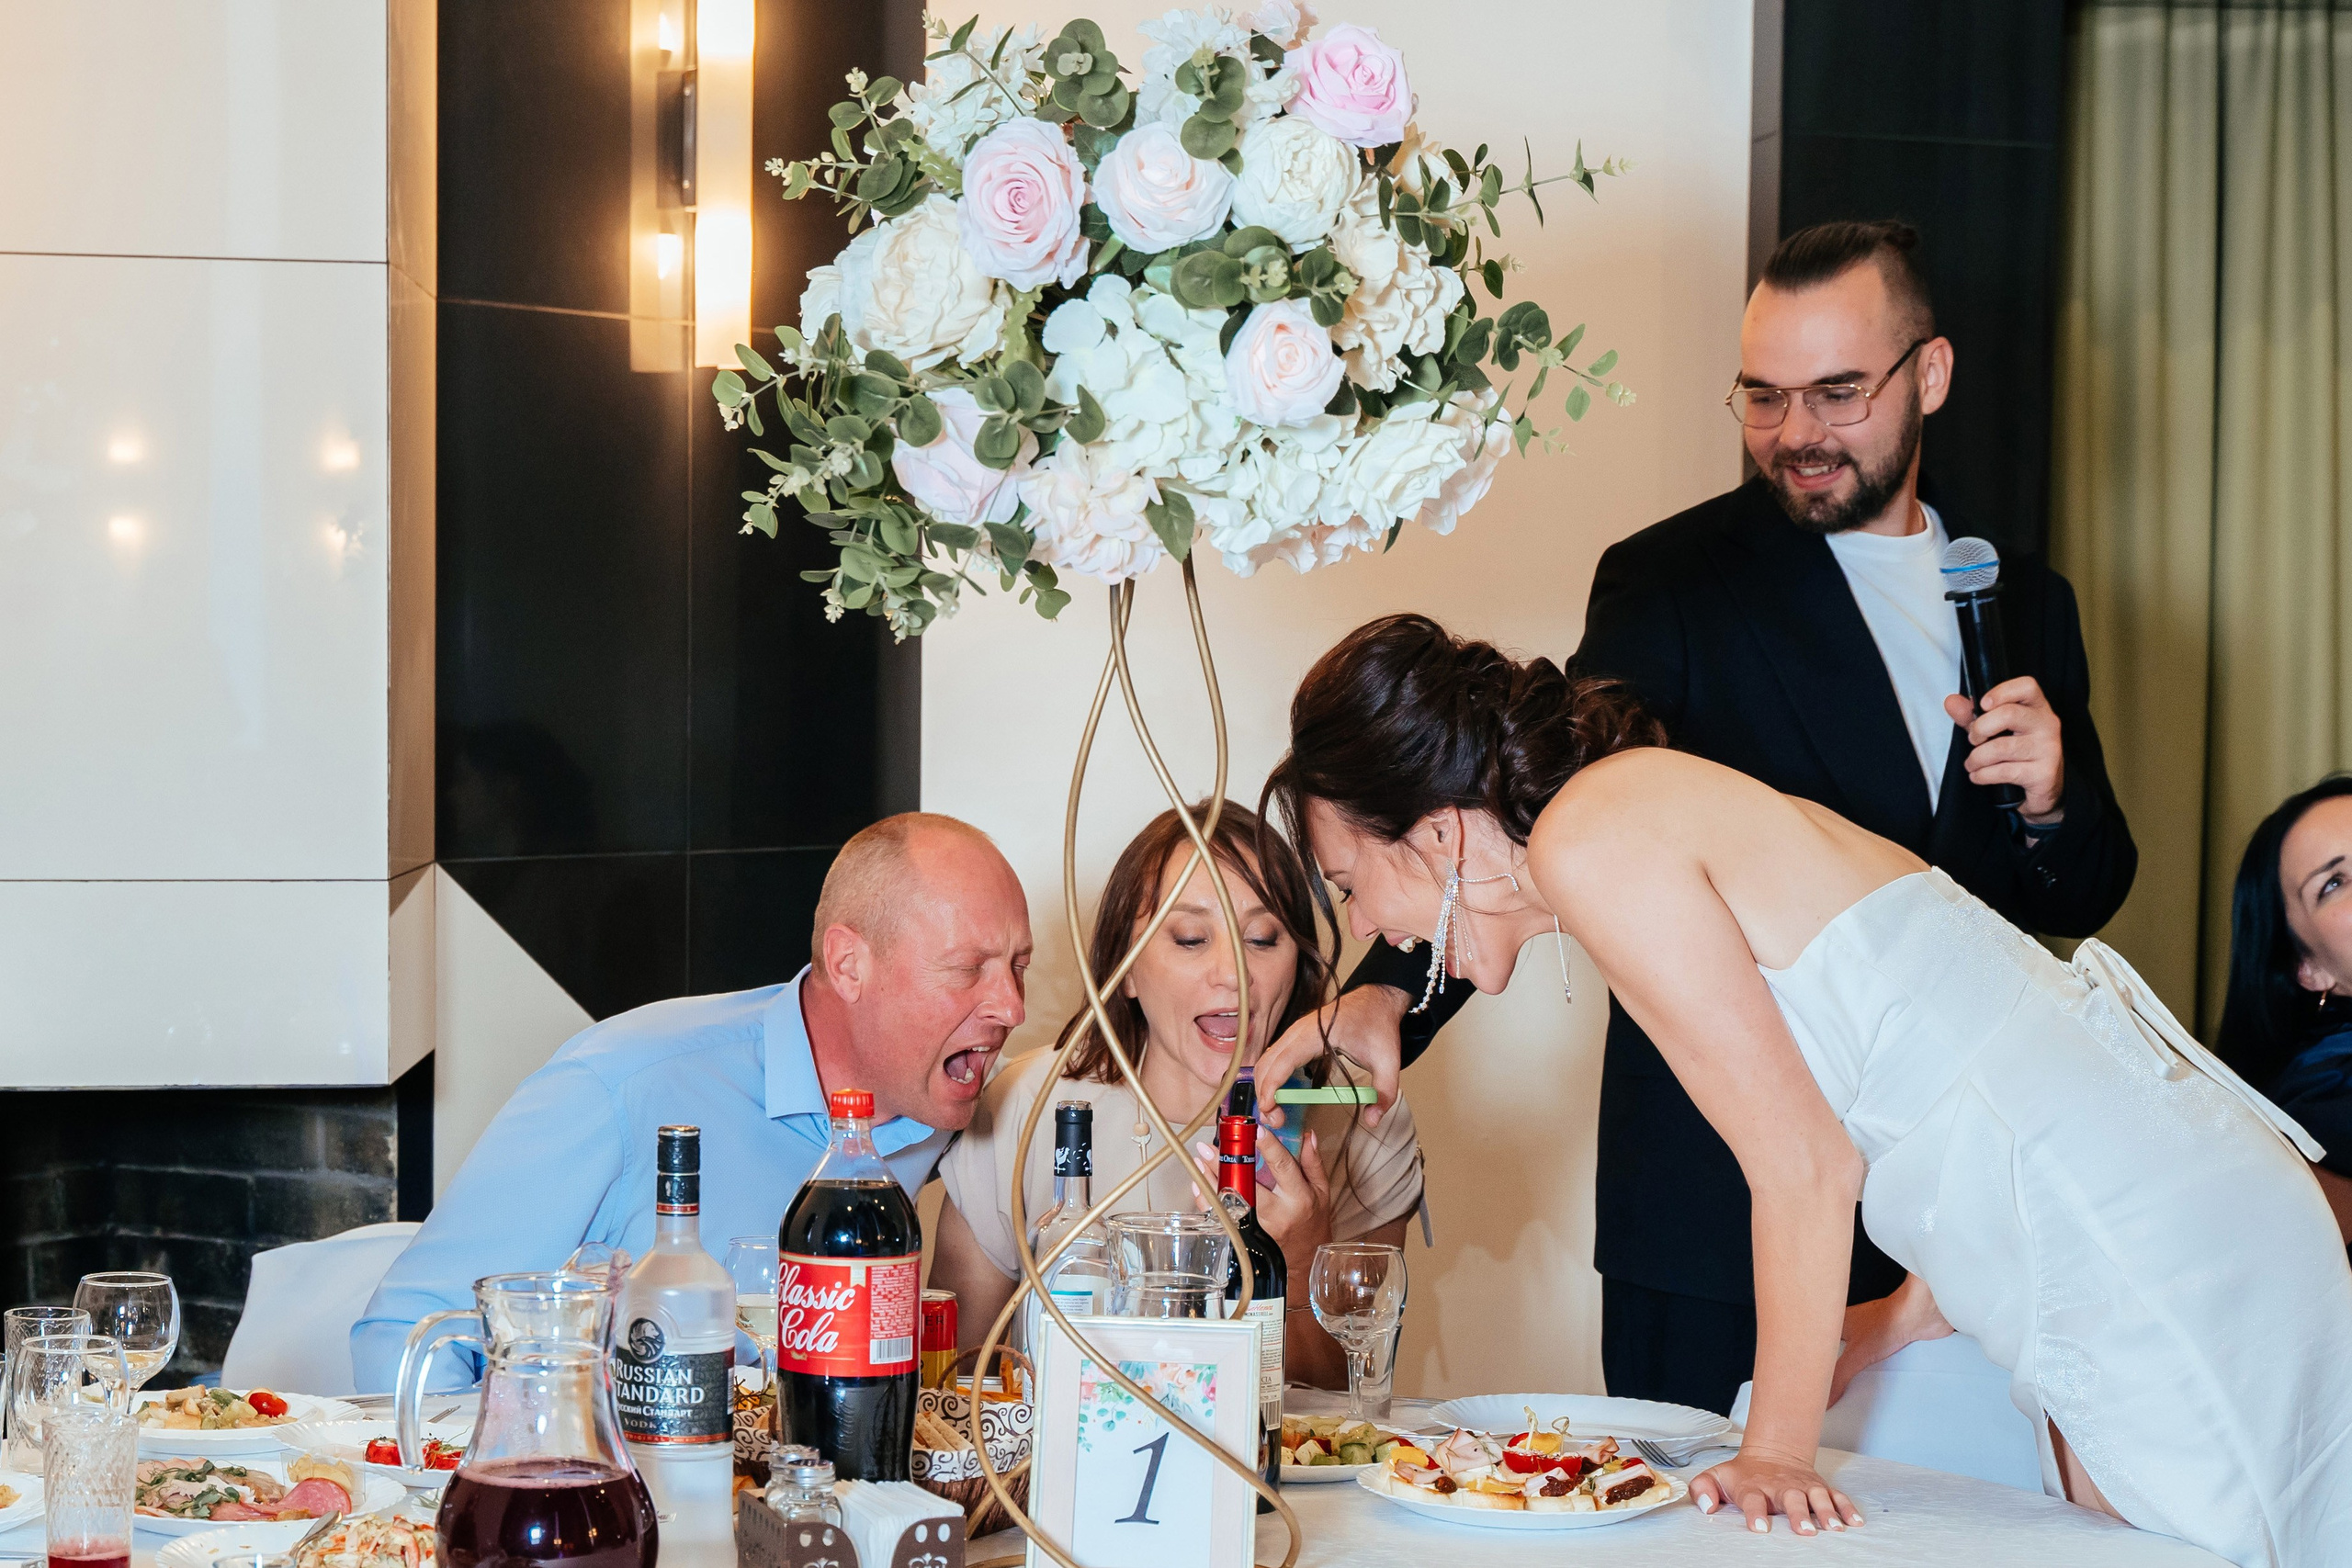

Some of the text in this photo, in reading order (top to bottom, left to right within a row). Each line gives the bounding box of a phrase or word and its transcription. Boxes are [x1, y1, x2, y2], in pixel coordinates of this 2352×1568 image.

[780, 1304, 839, 1353] Cola
[616, 1359, 693, 1384] RUSSIAN
[616, 1381, 705, 1404] TANDARD
[1114, 1432, 1170, 1525] 1
